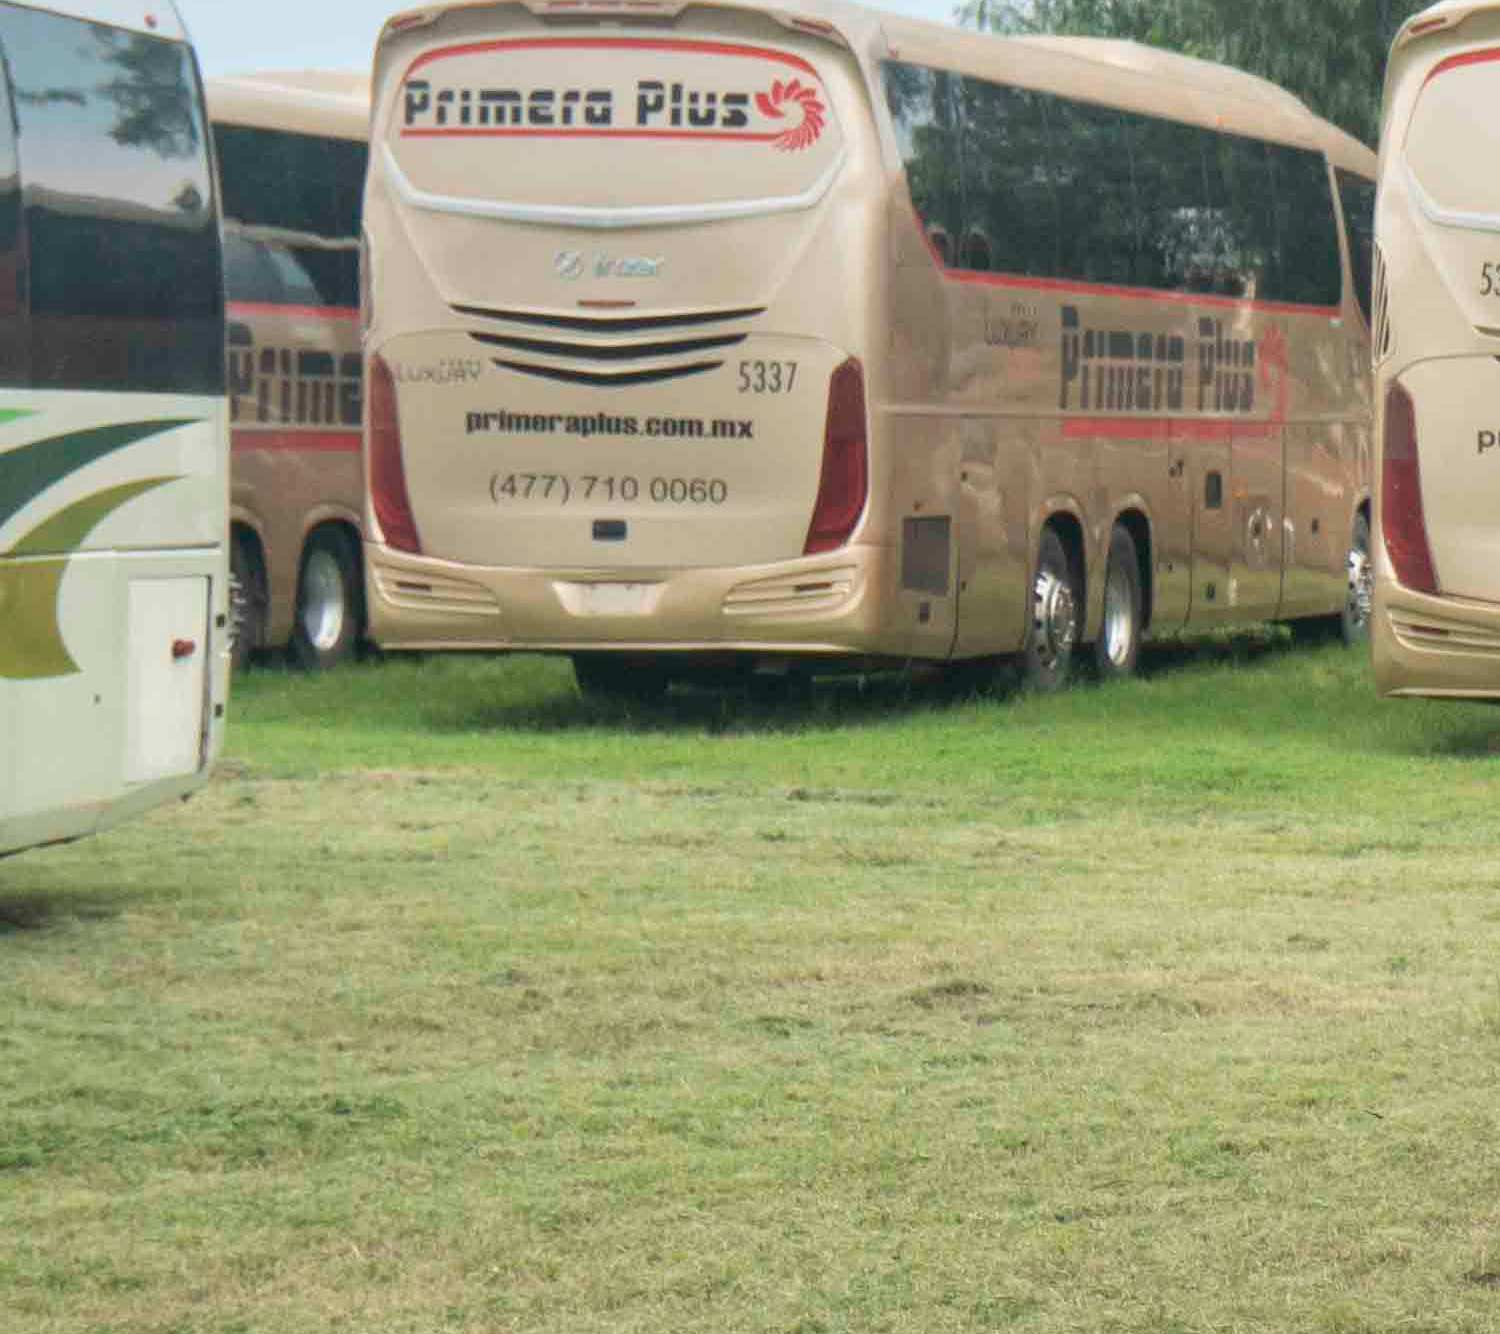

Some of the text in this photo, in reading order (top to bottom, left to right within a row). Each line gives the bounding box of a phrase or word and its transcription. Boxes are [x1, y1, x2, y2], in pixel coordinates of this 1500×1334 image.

[403, 79, 750, 128] Primera Plus
[1060, 303, 1255, 412] Primera Plus
[736, 361, 799, 395] 5337
[465, 409, 754, 439] primeraplus.com.mx
[488, 473, 728, 505] (477) 710 0060
